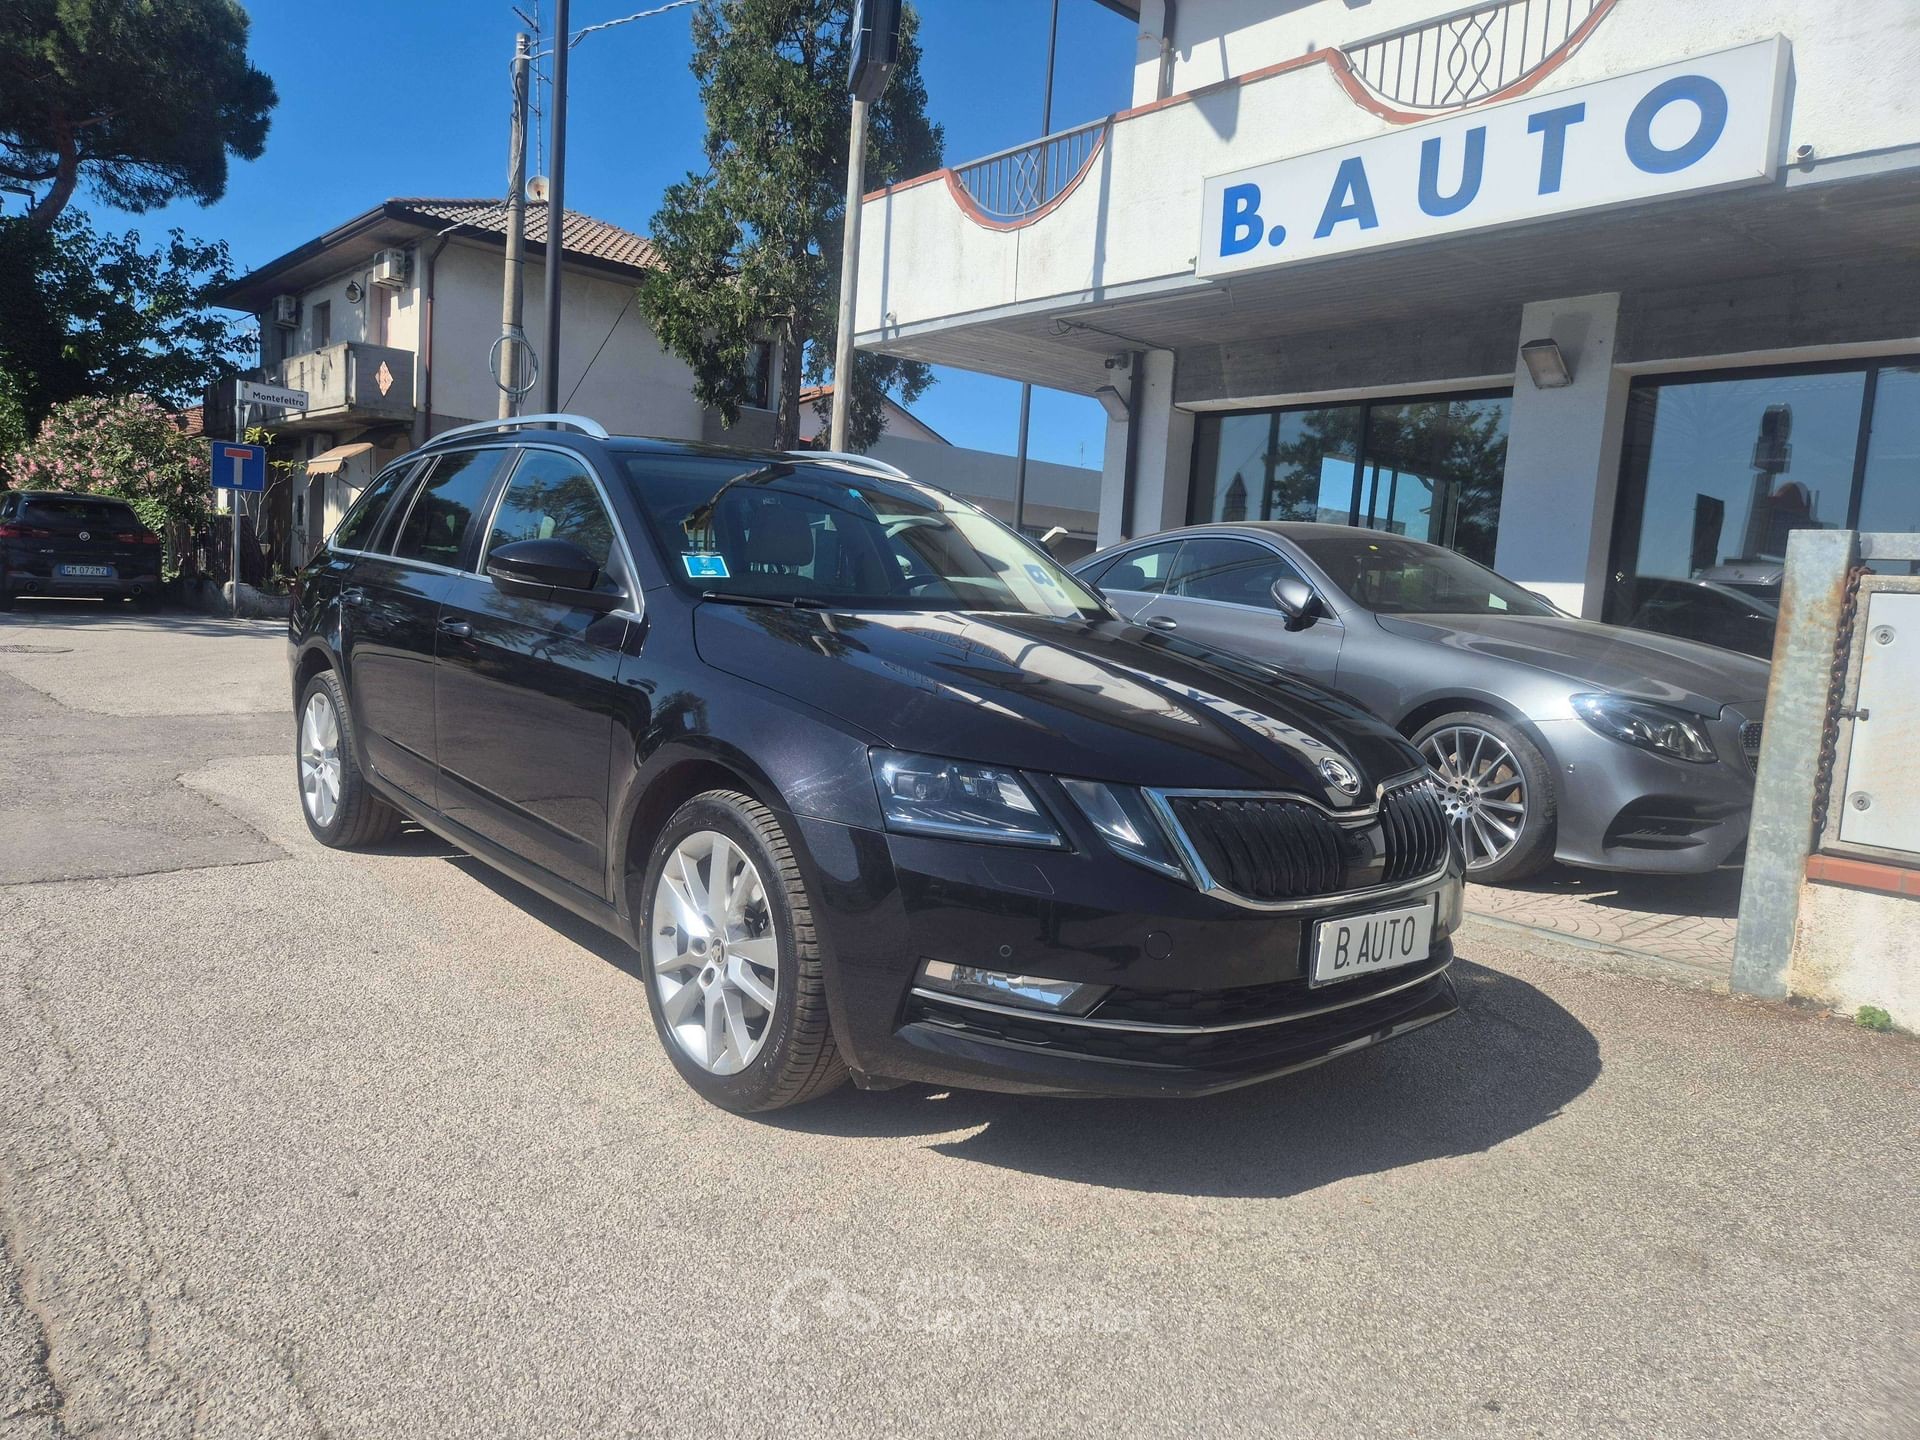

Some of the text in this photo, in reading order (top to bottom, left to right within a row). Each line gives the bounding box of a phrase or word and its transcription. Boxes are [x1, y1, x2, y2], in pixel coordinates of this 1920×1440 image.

[1219, 74, 1729, 257] B. AUTO
[253, 391, 305, 407] Montefeltro
[1334, 915, 1416, 970] B. AUTO
